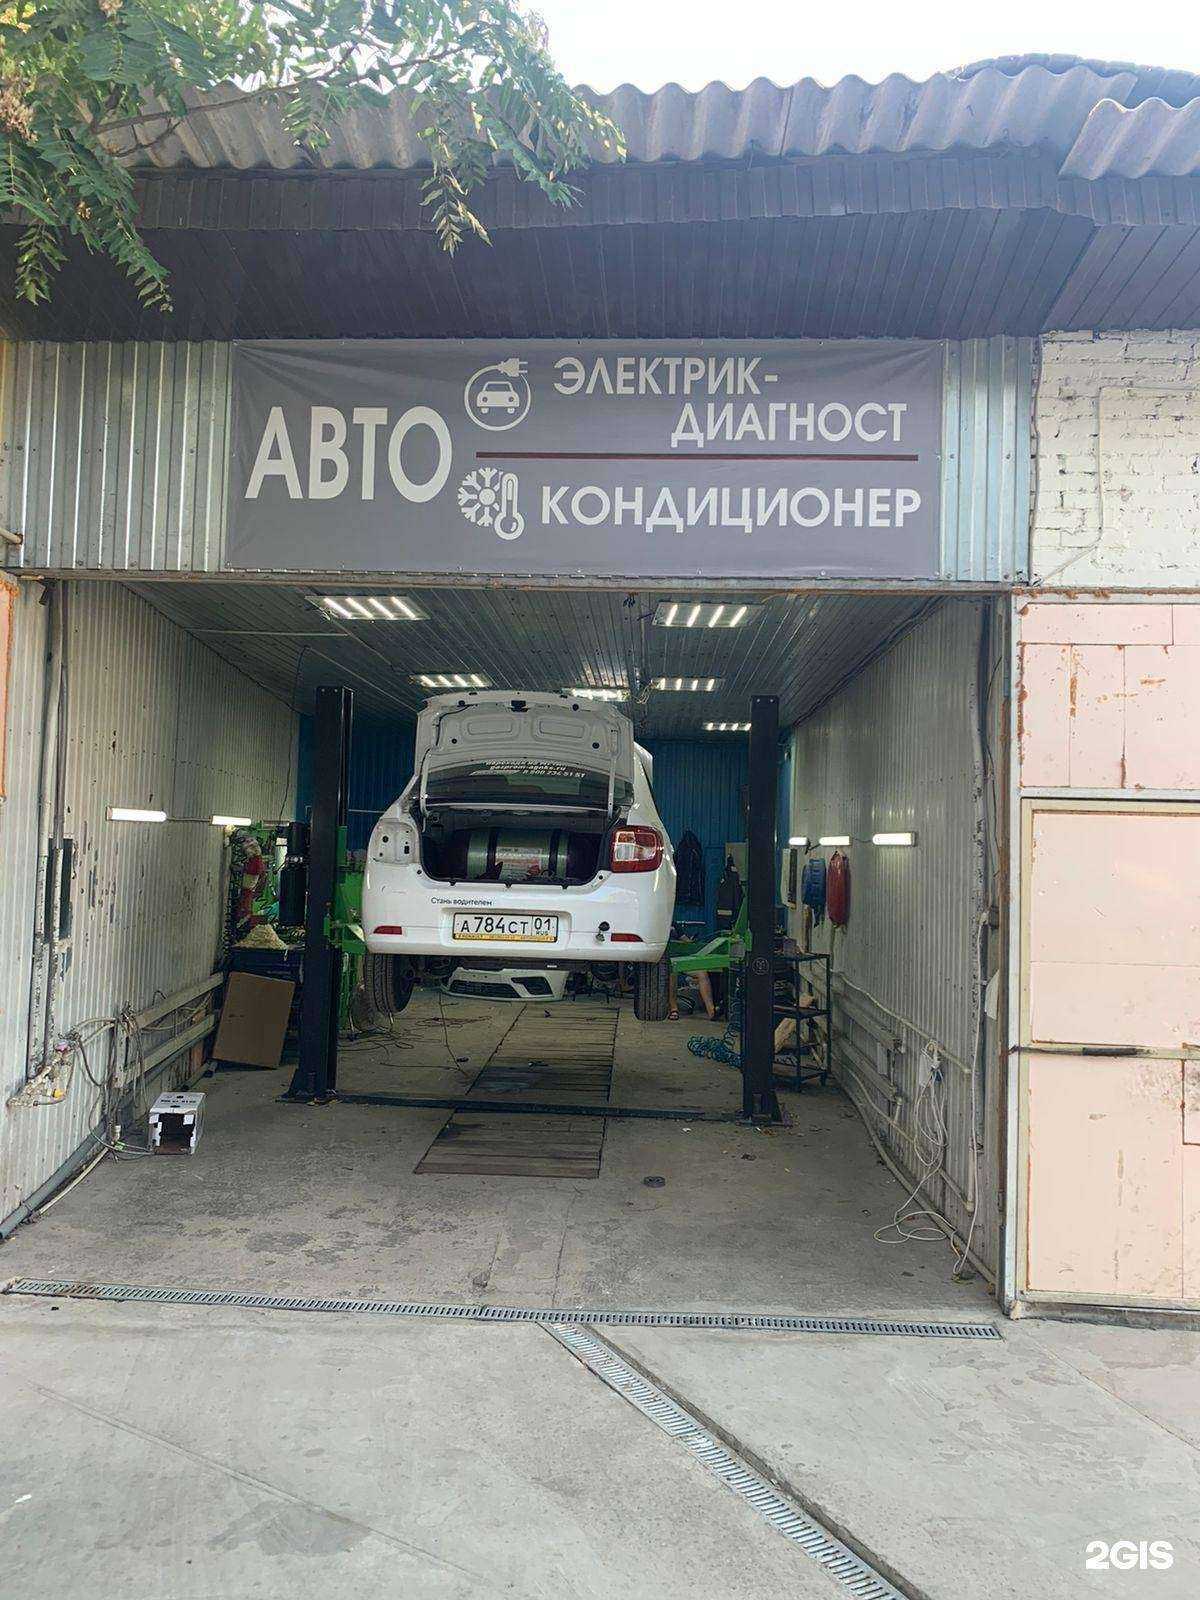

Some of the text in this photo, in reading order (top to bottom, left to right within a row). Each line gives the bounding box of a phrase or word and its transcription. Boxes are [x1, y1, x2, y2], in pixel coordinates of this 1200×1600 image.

[554, 356, 778, 395] ЭЛЕКТРИК-
[671, 402, 908, 449] ДИАГНОСТ
[245, 405, 453, 503] АВТО
[541, 486, 922, 534] КОНДИЦИОНЕР
[534, 918, 551, 931] 01
